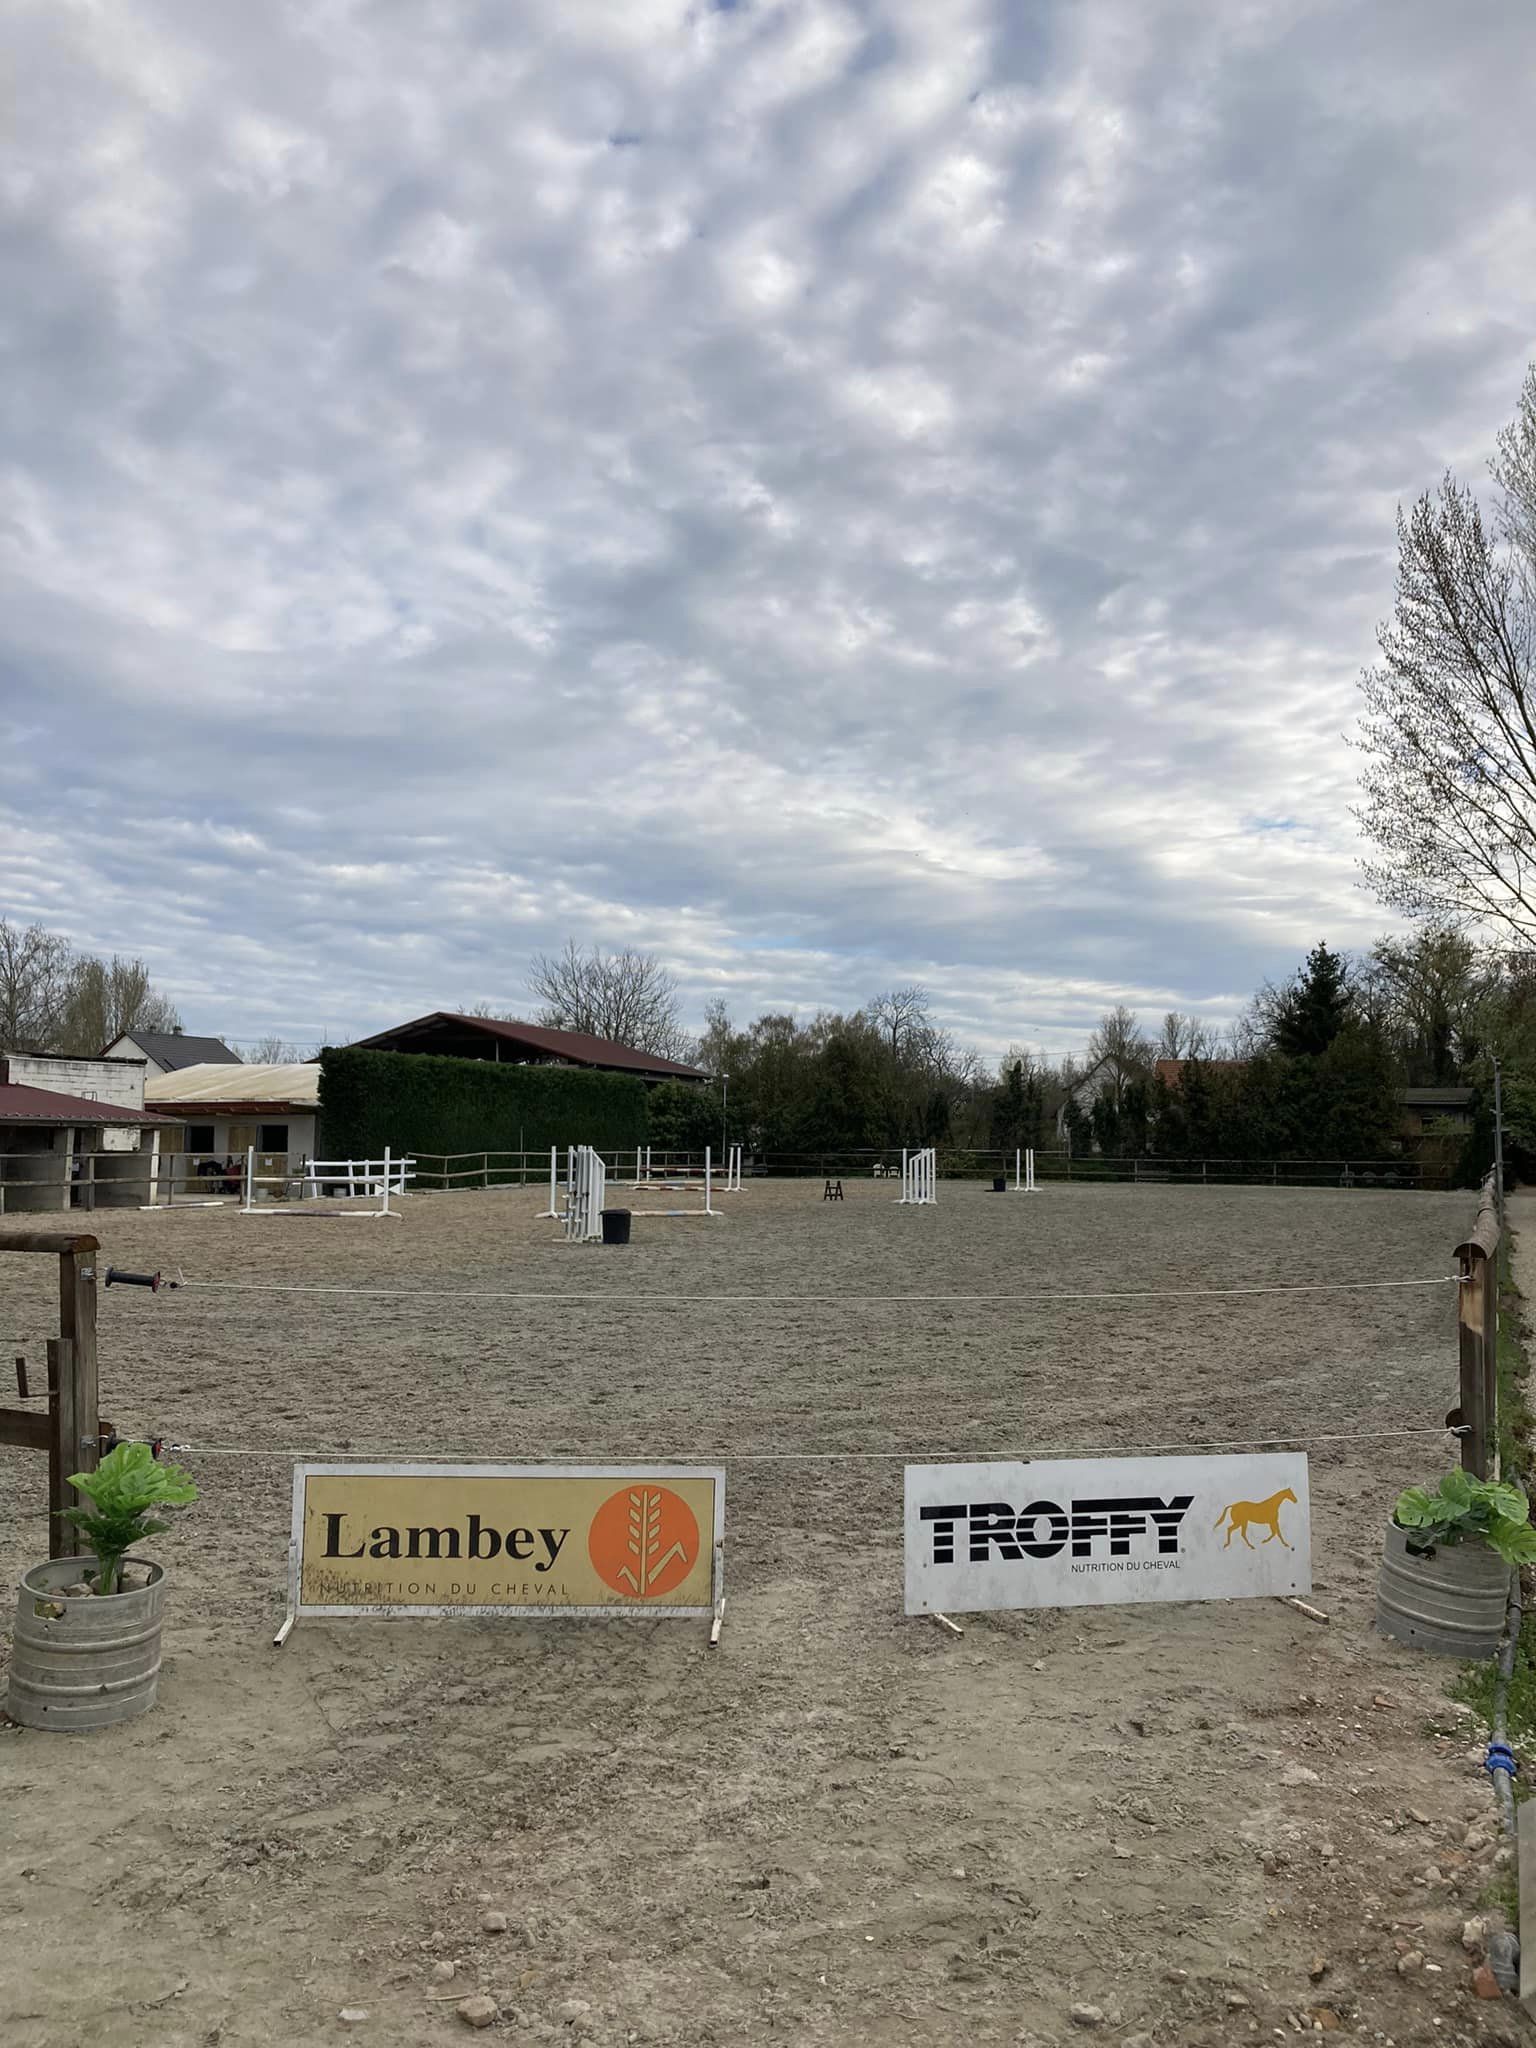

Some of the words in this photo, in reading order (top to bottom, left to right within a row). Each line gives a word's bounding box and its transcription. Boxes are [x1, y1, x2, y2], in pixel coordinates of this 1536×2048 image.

[320, 1512, 571, 1571] Lambey
[919, 1495, 1195, 1564] TROFFY
[1071, 1562, 1124, 1573] NUTRITION
[1126, 1561, 1140, 1571] DU
[1143, 1560, 1181, 1570] CHEVAL
[320, 1582, 436, 1595] NUTRITION
[450, 1583, 476, 1595] DU
[491, 1583, 568, 1595] CHEVAL
